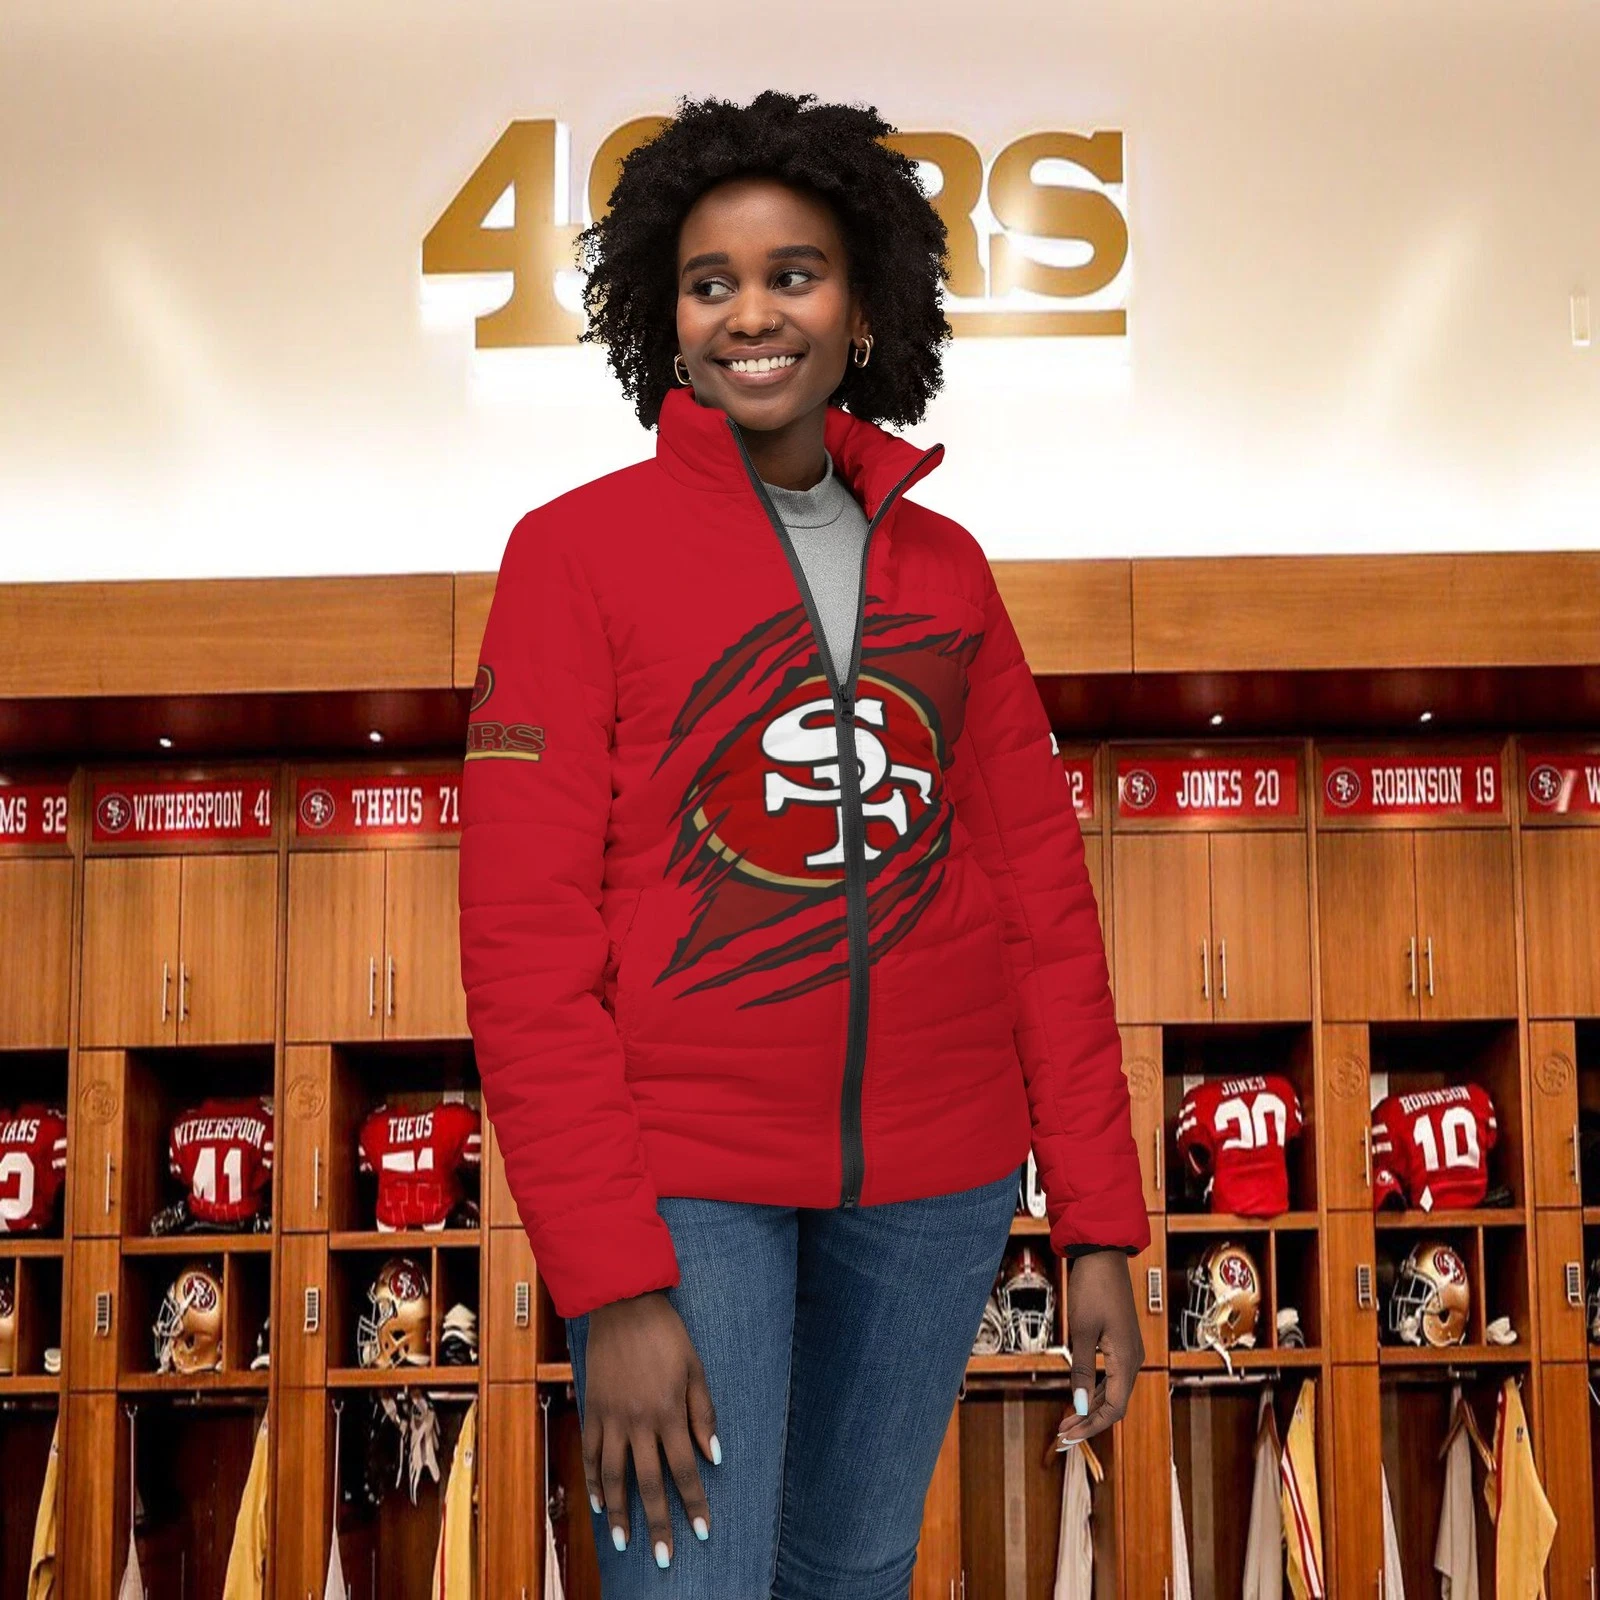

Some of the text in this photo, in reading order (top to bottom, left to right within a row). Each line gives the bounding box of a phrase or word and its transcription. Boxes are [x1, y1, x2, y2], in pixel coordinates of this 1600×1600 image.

[467, 721, 547, 752] RS
[1176, 770, 1242, 807] JONES
[1254, 769, 1280, 806] 20
[1371, 767, 1462, 805] ROBINSON
[1475, 766, 1495, 804] 19
[42, 796, 67, 834] 32
[133, 790, 242, 831] WITHERSPOON
[254, 788, 271, 827] 41
[352, 788, 423, 826] THEUS
[439, 785, 459, 824] 71
[1221, 1075, 1267, 1096] JONES
[1399, 1085, 1471, 1115] ROBINSON
[0, 1119, 40, 1143] IAMS
[174, 1116, 266, 1149] WITHERSPOON
[388, 1112, 435, 1144] THEUS
[193, 1147, 242, 1204] 41
